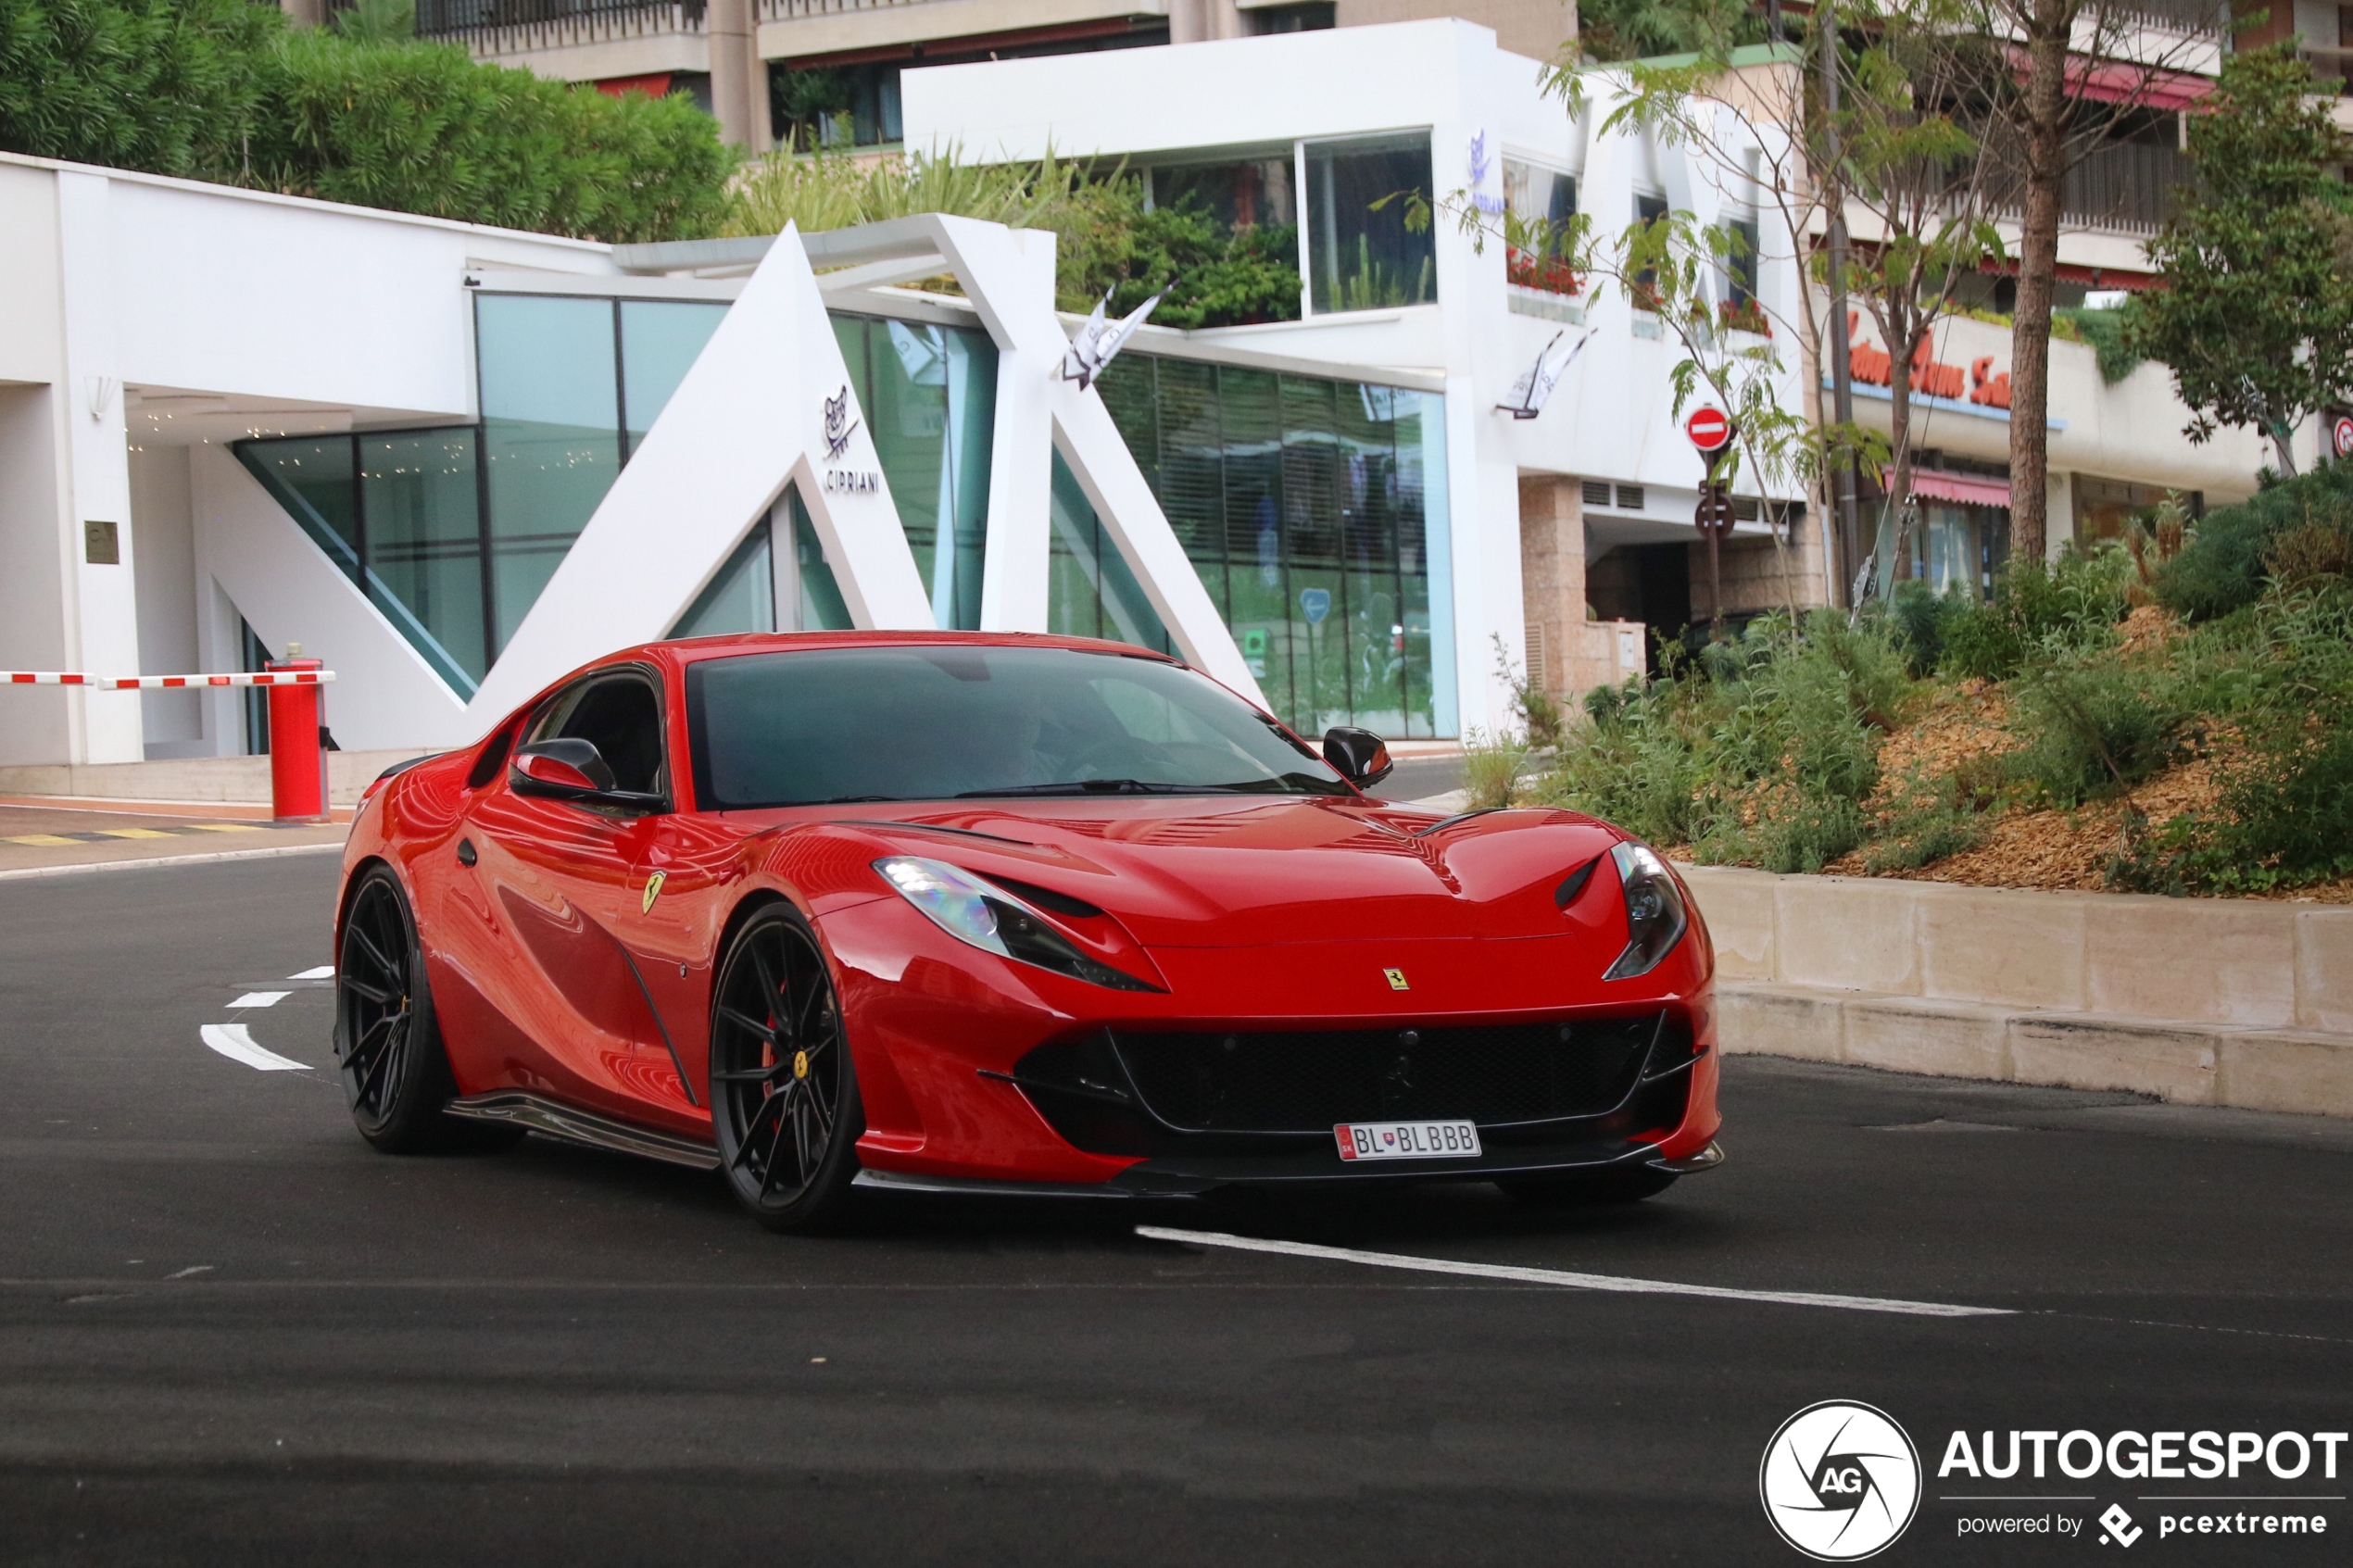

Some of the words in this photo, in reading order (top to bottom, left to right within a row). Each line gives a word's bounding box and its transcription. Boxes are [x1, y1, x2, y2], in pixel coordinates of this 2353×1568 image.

[826, 470, 878, 494] CIPRIANI
[1354, 1128, 1385, 1154] BL
[1397, 1125, 1474, 1152] BLBBB
